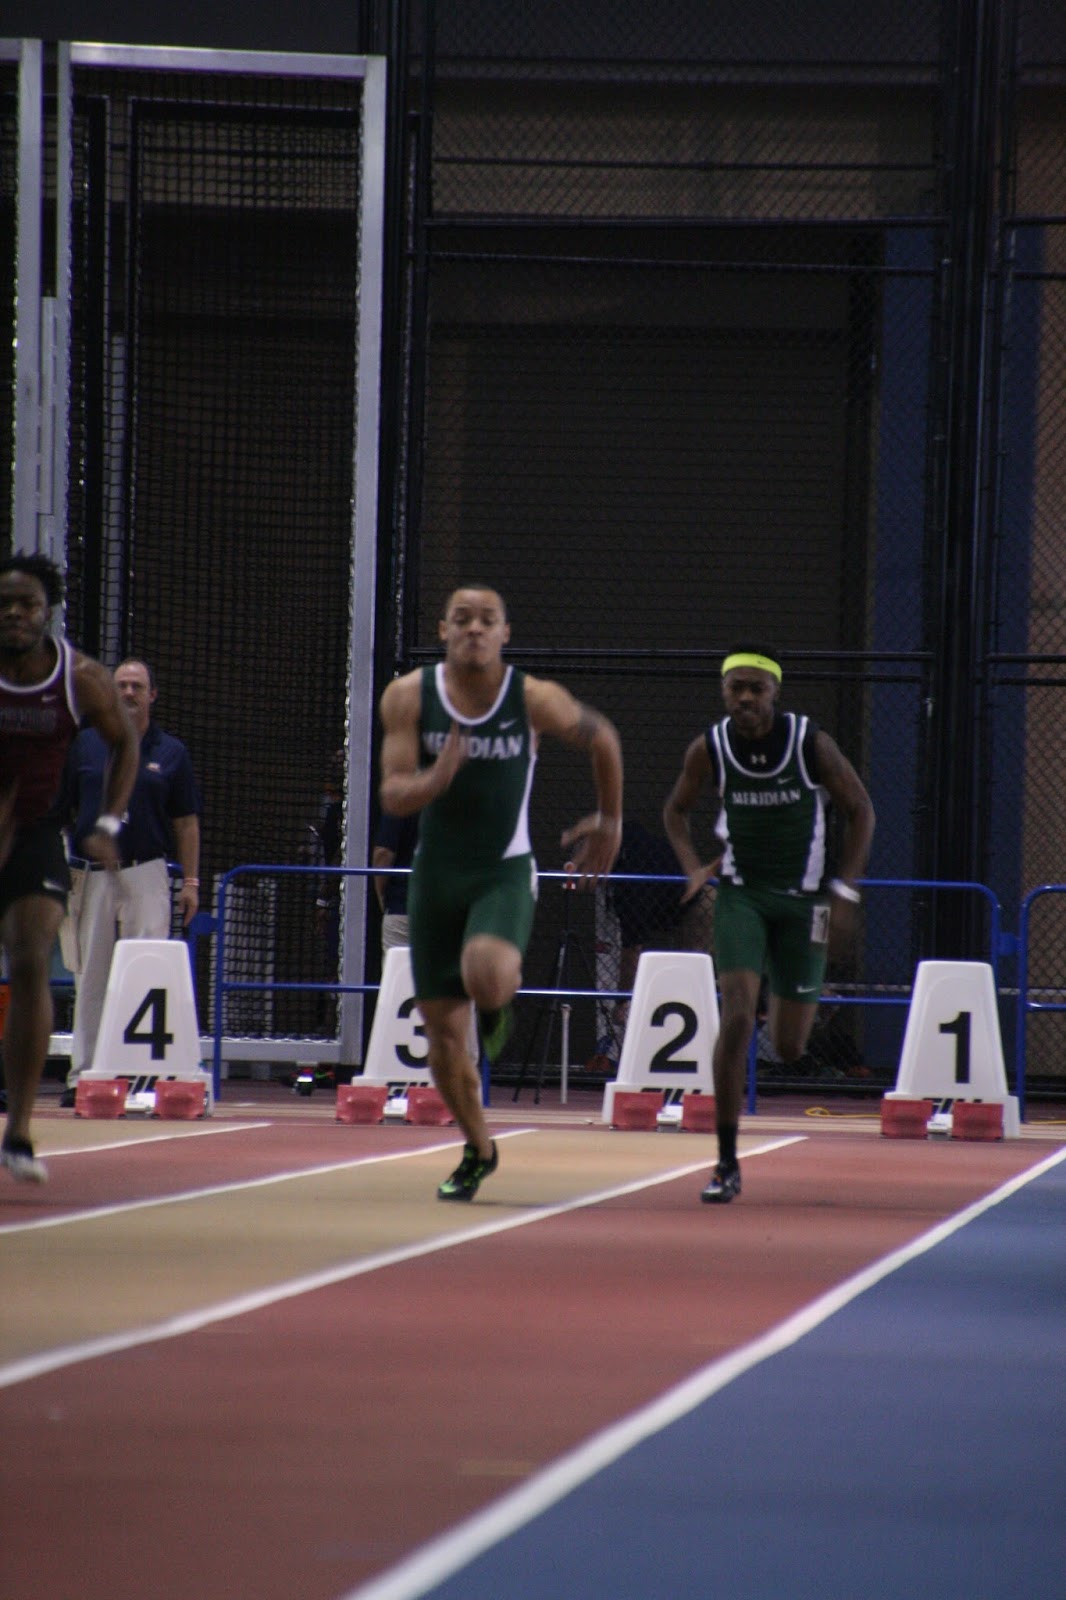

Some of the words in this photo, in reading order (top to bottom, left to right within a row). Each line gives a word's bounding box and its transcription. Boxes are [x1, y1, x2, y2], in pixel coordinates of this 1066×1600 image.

[123, 988, 174, 1060] 4
[395, 996, 429, 1069] 3
[649, 1001, 698, 1073] 2
[939, 1011, 971, 1083] 1
